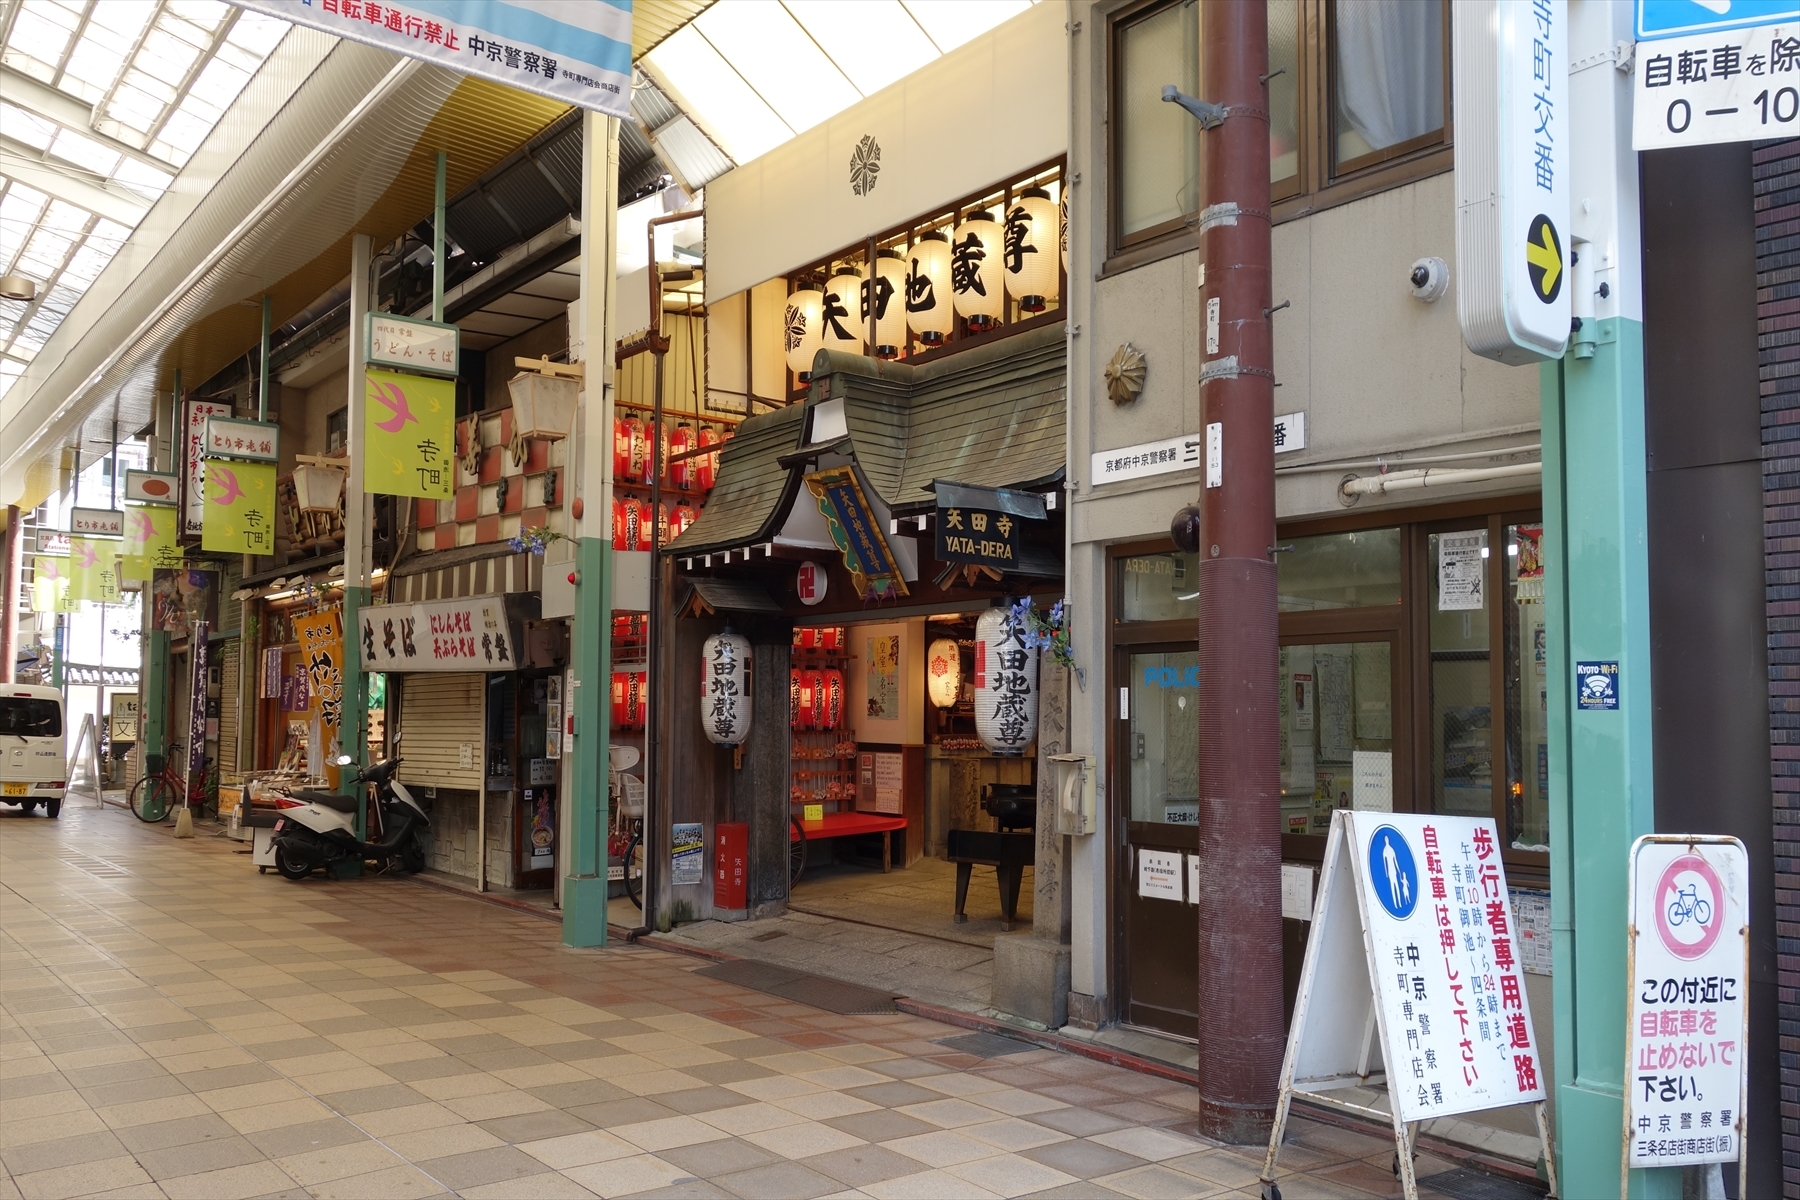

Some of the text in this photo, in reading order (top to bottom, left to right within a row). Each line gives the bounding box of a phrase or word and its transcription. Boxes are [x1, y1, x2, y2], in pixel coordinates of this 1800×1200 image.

[322, 0, 460, 51] 自転車通行禁止
[468, 33, 558, 80] 中京警察署
[377, 325, 395, 334] 四代目
[374, 338, 453, 363] うどん・そば
[1105, 447, 1177, 473] 京都府中京警察署
[946, 508, 1014, 539] 矢田寺
[945, 535, 1013, 560] YATA-DERA
[429, 611, 473, 636] にしんそば
[362, 616, 418, 662] 生そば
[432, 636, 477, 660] 天ぷらそば
[709, 639, 739, 739] 矢田地蔵尊
[991, 613, 1034, 746] 矢田地蔵尊
[1167, 812, 1199, 823] 不正大麻・けし
[734, 857, 742, 886] 矢田寺
[1422, 824, 1480, 1088] 自転車は押して下さい
[1460, 841, 1507, 1062] 午前10時から24時まで
[1472, 826, 1538, 1093] 歩行者専用道路
[1641, 976, 1737, 1004] この付近に
[1393, 945, 1431, 1107] 寺町専門店会
[1406, 942, 1443, 1105] 中京警察署
[1640, 1009, 1718, 1038] 自転車を
[1638, 1040, 1736, 1071] 止めないで
[1638, 1075, 1704, 1102] 下さい。
[1637, 1109, 1733, 1134] 中京警察署
